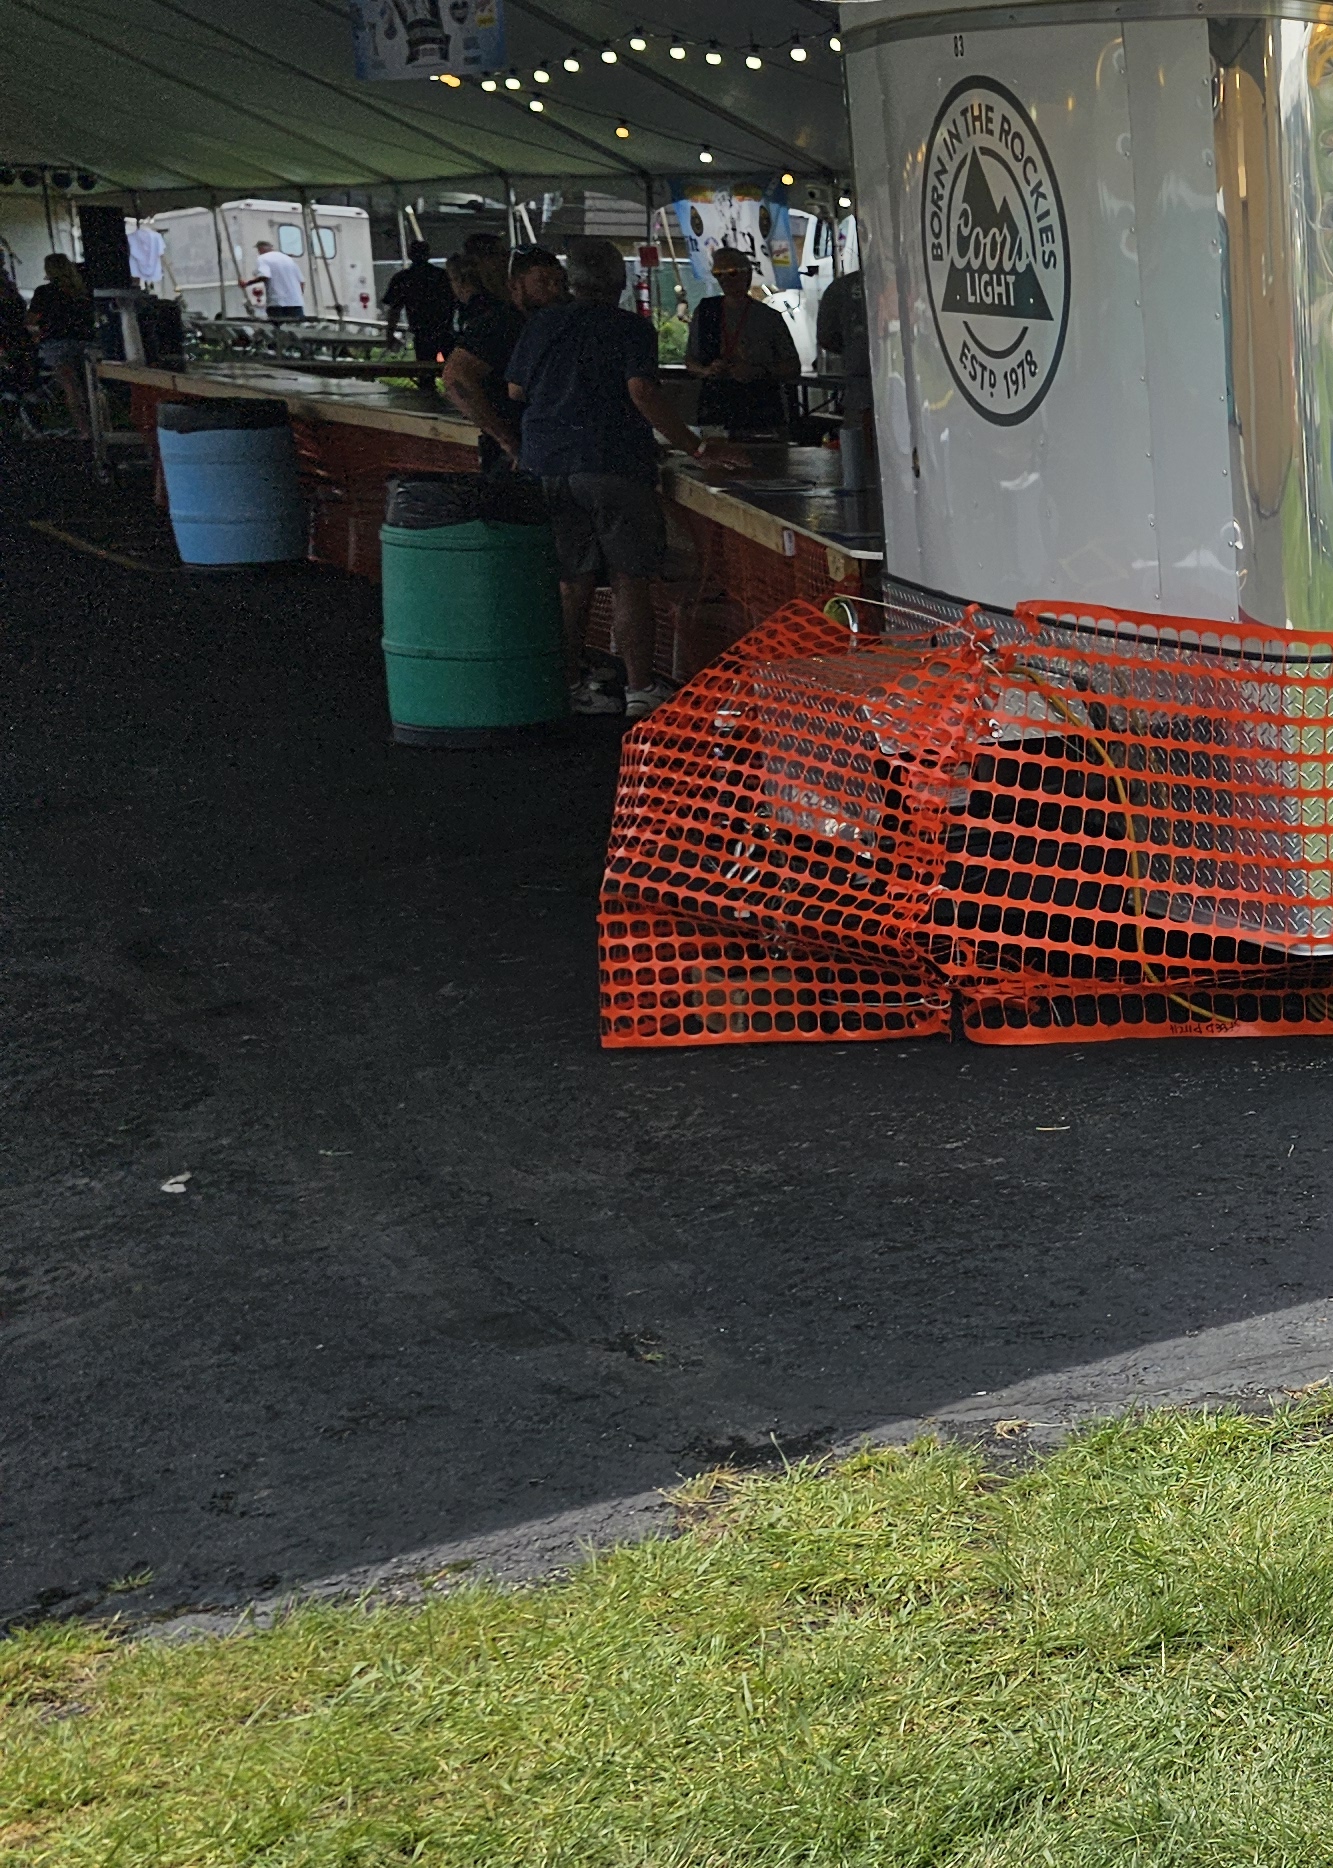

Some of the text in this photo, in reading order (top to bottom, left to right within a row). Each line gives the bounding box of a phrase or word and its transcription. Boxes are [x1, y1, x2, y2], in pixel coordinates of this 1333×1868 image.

[953, 35, 965, 57] 83
[930, 103, 1057, 270] BORN IN THE ROCKIES
[954, 203, 1031, 272] Coors
[966, 272, 1015, 306] LIGHT
[1003, 349, 1038, 399] 1978
[1169, 1023, 1203, 1035] PITCH
